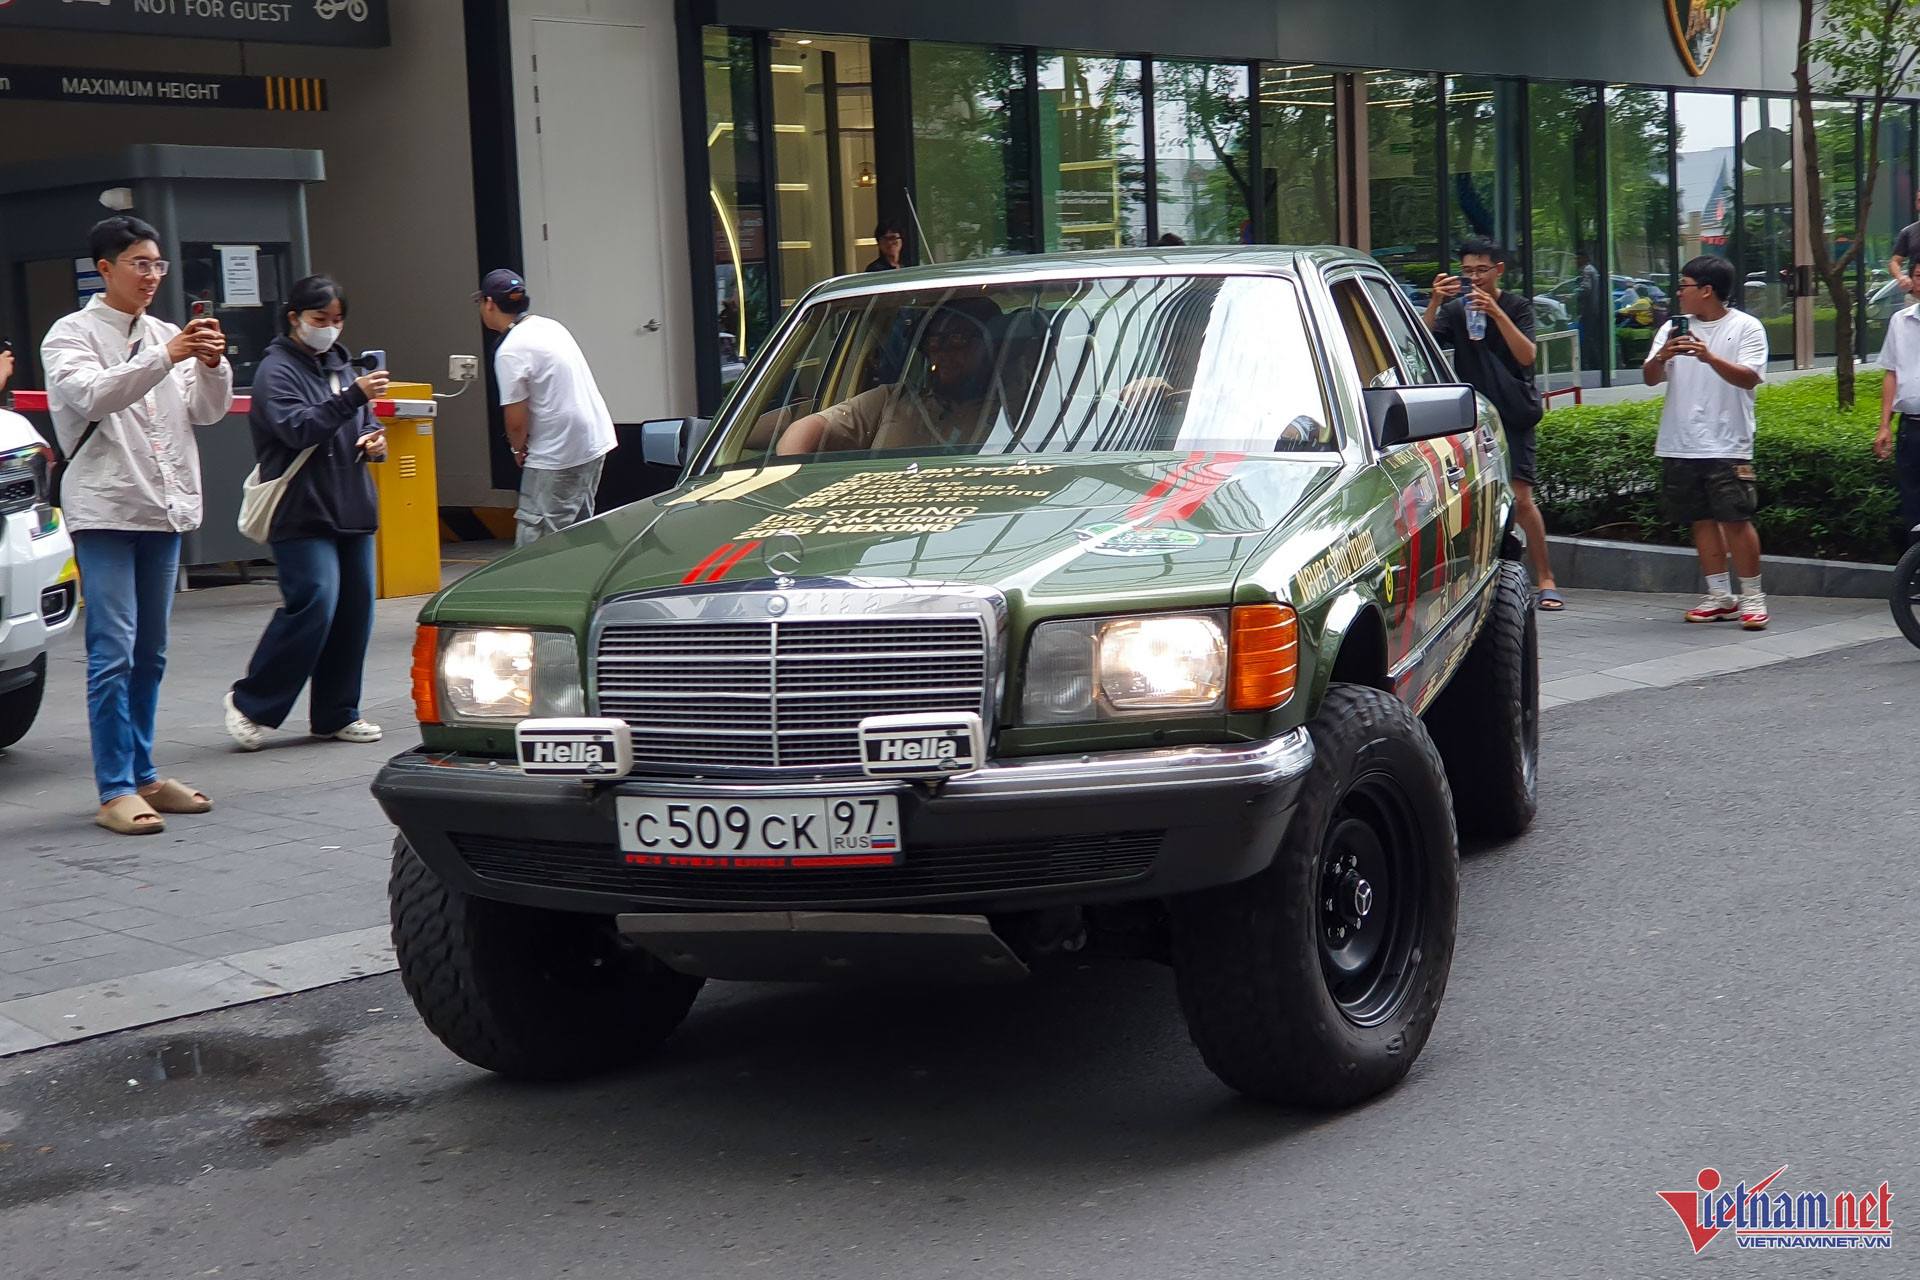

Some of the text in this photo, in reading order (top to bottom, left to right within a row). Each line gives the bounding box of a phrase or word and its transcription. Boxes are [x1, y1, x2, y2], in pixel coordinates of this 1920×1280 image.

[134, 0, 292, 22] NOT FOR GUEST
[62, 77, 221, 100] MAXIMUM HEIGHT
[990, 468, 1053, 476] DAY
[795, 489, 1051, 504] NO power steering
[807, 489, 850, 499] NO
[852, 484, 929, 495] brake
[783, 501, 828, 510] NO
[746, 515, 965, 531] 2500 KM along
[761, 506, 980, 524] be STRONG
[816, 523, 956, 534] MEKONG
[1295, 557, 1332, 604] Never
[533, 742, 603, 763] Hella
[880, 738, 957, 761] Hella
[833, 800, 880, 835] 97
[834, 836, 870, 849] RUS
